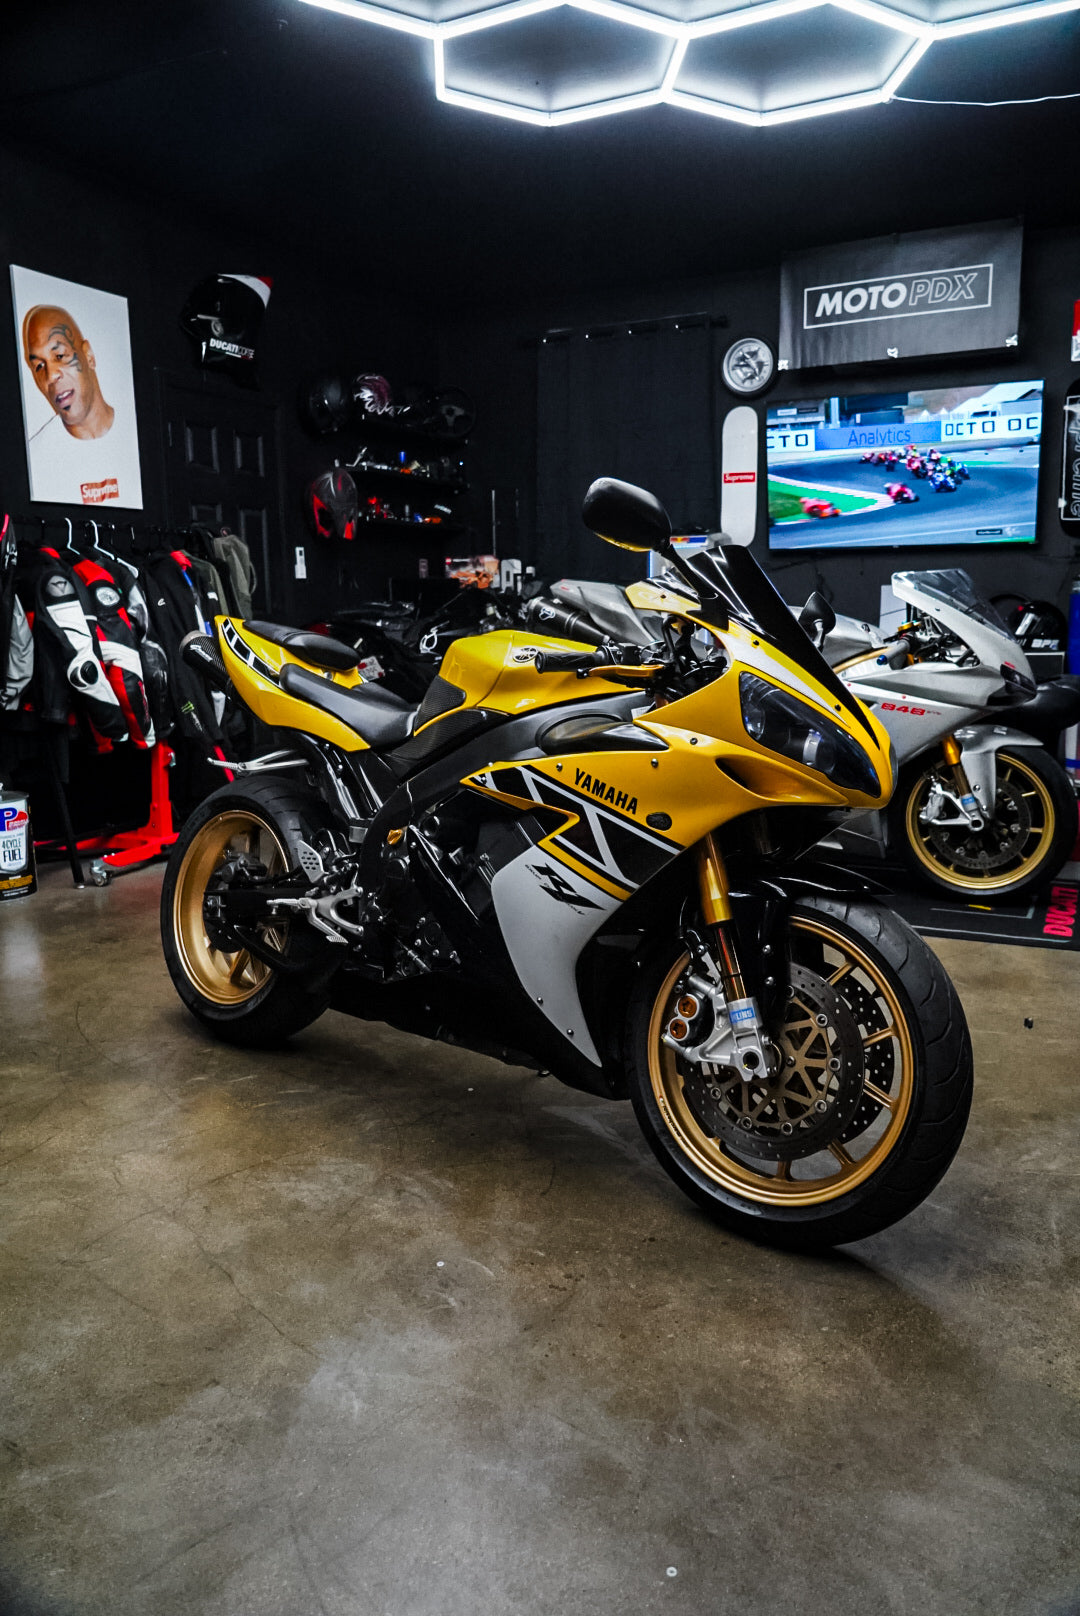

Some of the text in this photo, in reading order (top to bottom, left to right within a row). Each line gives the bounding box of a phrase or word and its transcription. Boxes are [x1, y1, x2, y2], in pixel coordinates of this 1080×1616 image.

[847, 428, 911, 447] Analytics
[574, 767, 638, 815] YAMAHA
[3, 848, 23, 863] FUEL
[1043, 886, 1078, 937] DUCATI
